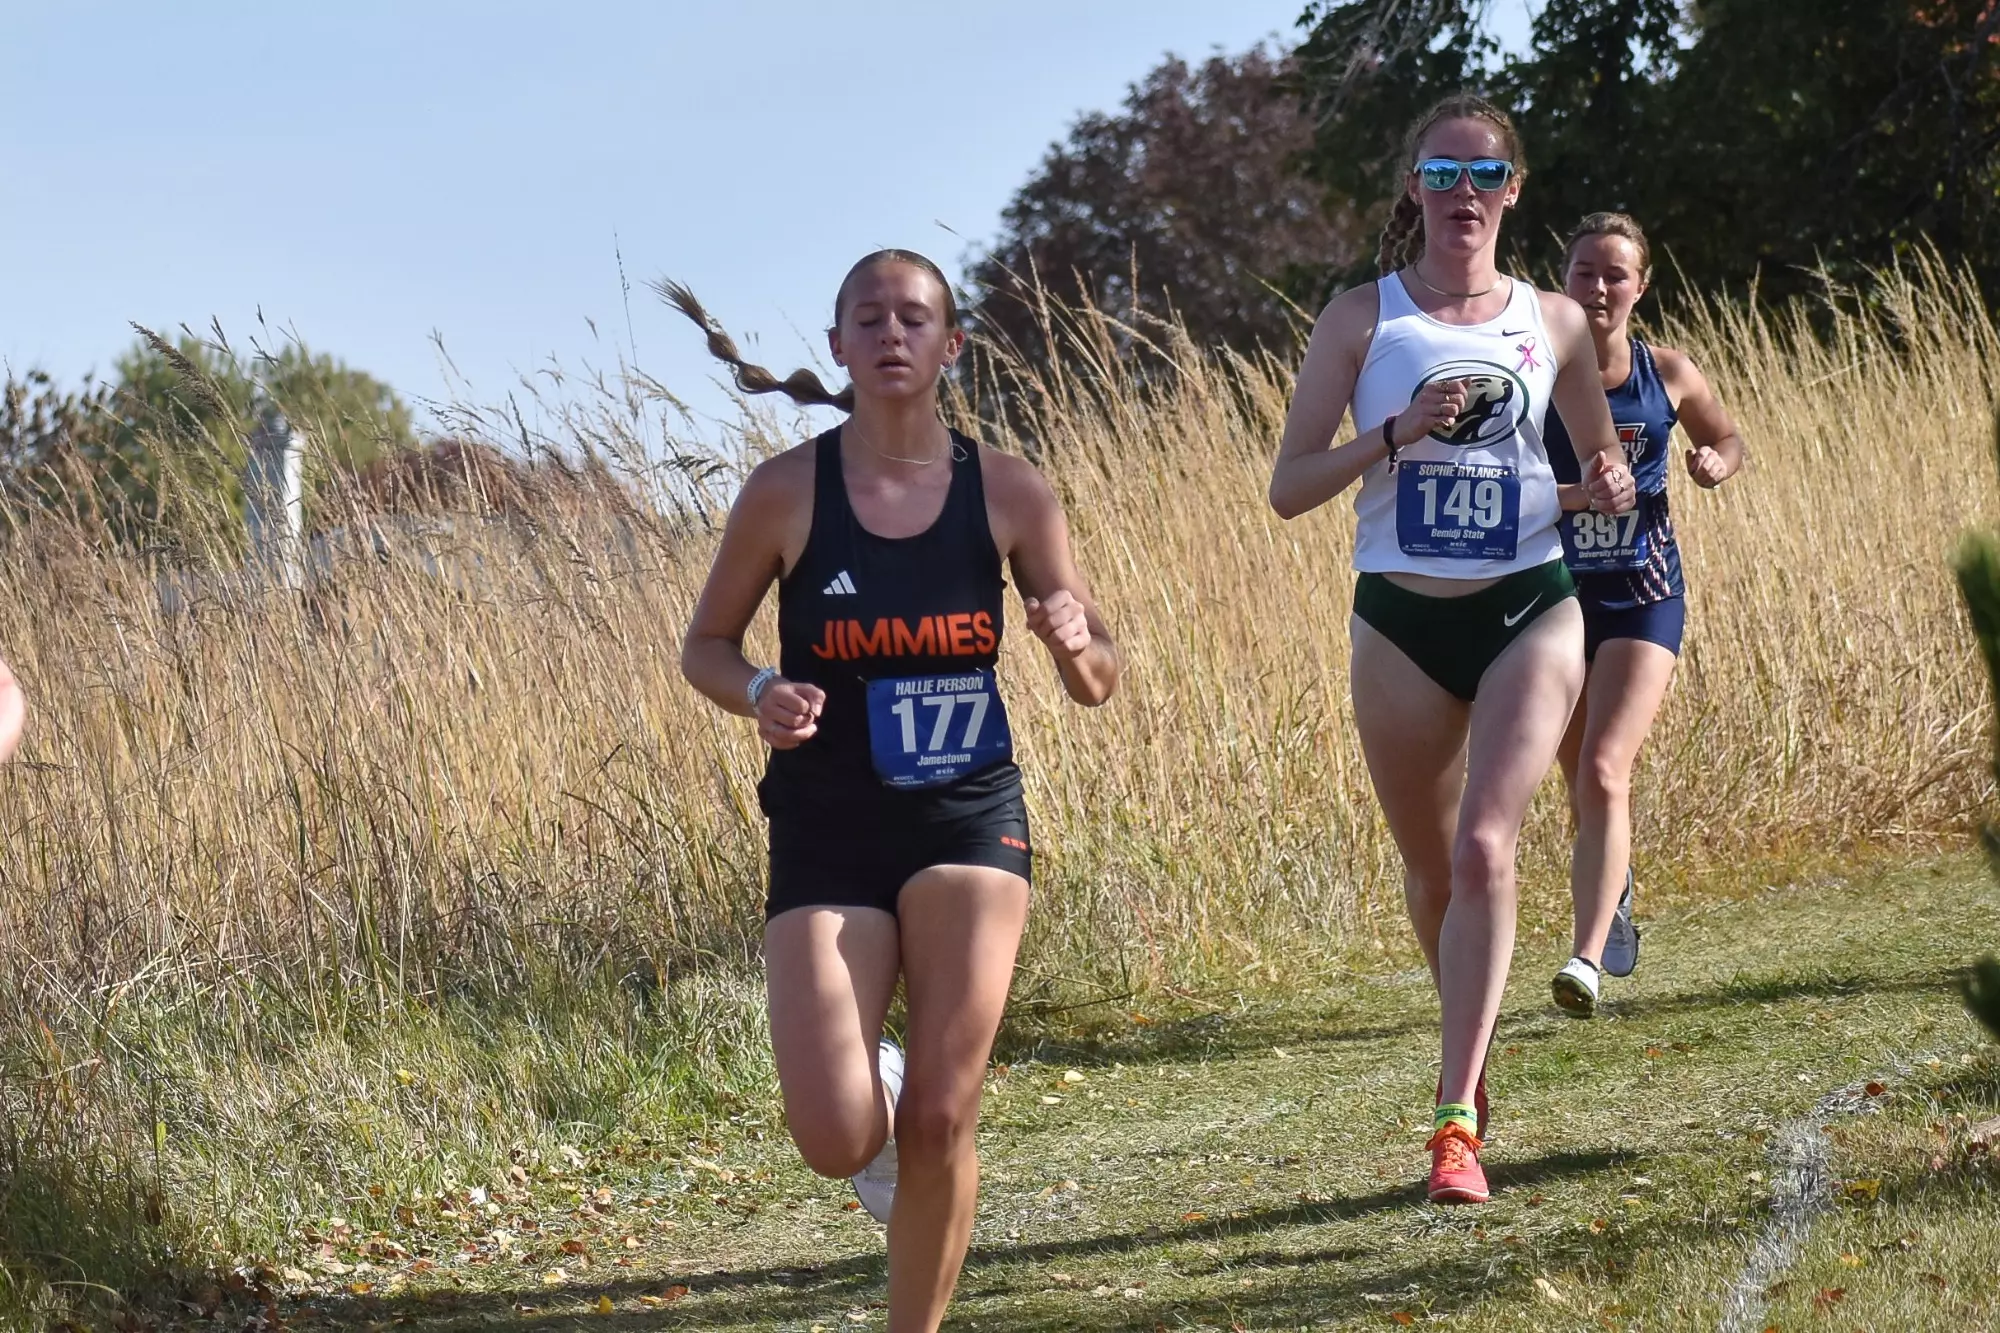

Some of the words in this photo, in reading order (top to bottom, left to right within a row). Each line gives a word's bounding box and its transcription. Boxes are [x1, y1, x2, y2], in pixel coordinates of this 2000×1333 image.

[1418, 464, 1455, 477] SOPHIE
[1457, 465, 1503, 479] RYLANCE
[1417, 478, 1503, 528] 149
[1431, 528, 1461, 539] Bemidji
[1462, 529, 1485, 540] State
[1572, 509, 1640, 550] 397
[1578, 549, 1611, 559] University
[1613, 549, 1620, 557] of
[1620, 548, 1639, 557] Mary
[811, 610, 996, 661] JIMMIES
[895, 679, 934, 697] HALLIE
[936, 676, 984, 693] PERSON
[891, 692, 990, 753] 177
[917, 752, 971, 767] Jamestown
